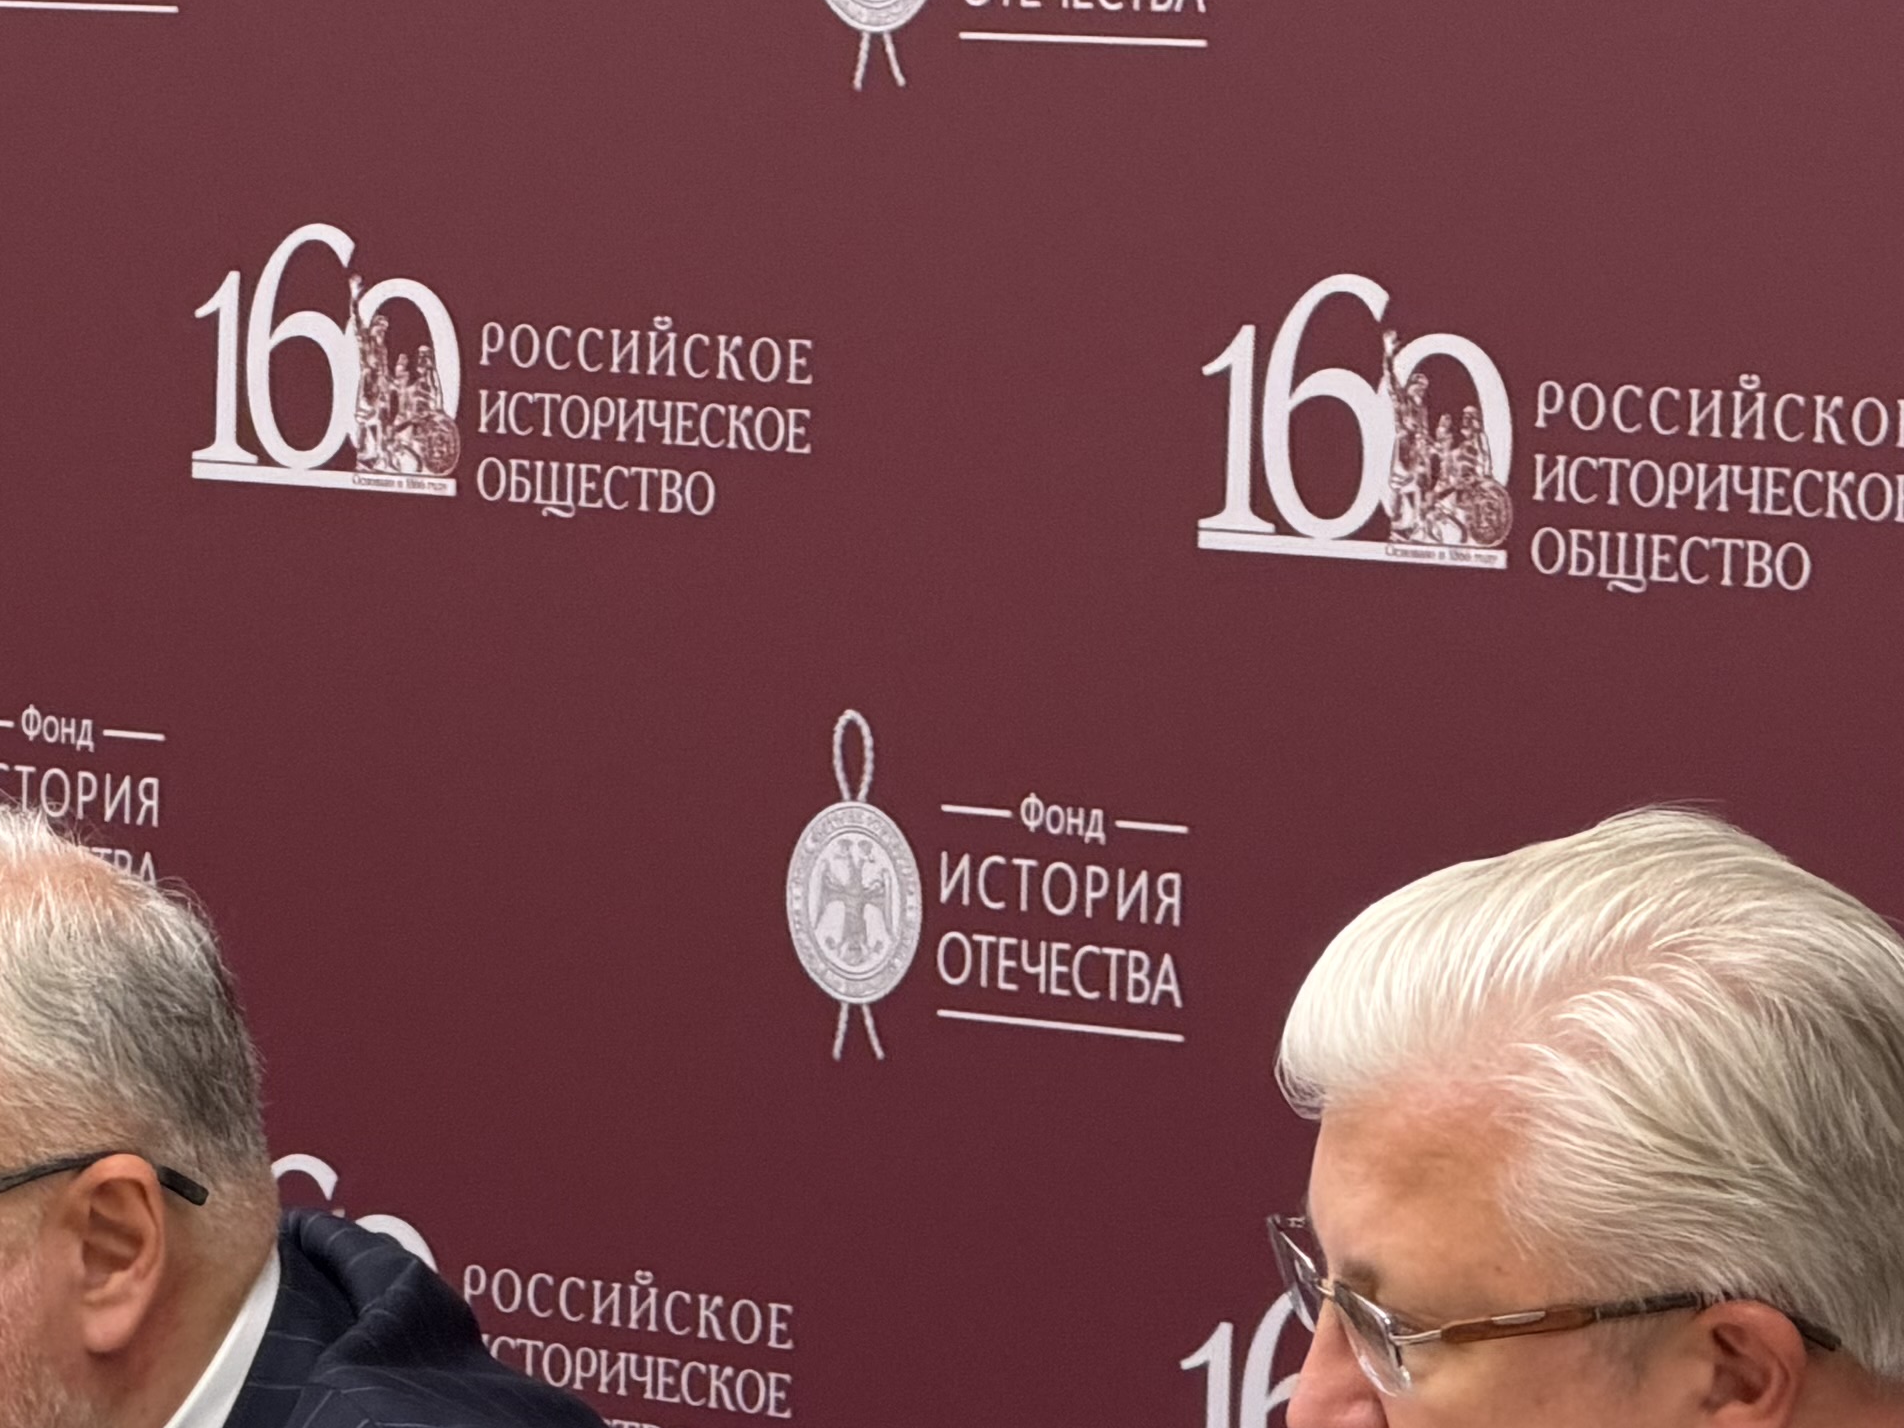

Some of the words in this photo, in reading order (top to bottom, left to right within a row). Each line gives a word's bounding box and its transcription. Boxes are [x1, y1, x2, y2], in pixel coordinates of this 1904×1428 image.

[479, 315, 814, 385] РОССИЙСКОЕ
[478, 389, 812, 454] ИСТОРИЧЕСКОЕ
[476, 456, 716, 518] ОБЩЕСТВО
[1532, 453, 1904, 524] ИСТОРИЧЕСКО
[1530, 526, 1811, 594] ОБЩЕСТВО
[21, 704, 95, 752] Фонд
[1020, 792, 1107, 845] Фонд
[939, 851, 1183, 927] ИСТОРИЯ
[937, 930, 1183, 1008] ОТЕЧЕСТВА
[463, 1263, 795, 1350] РОССИЙСКОЕ
